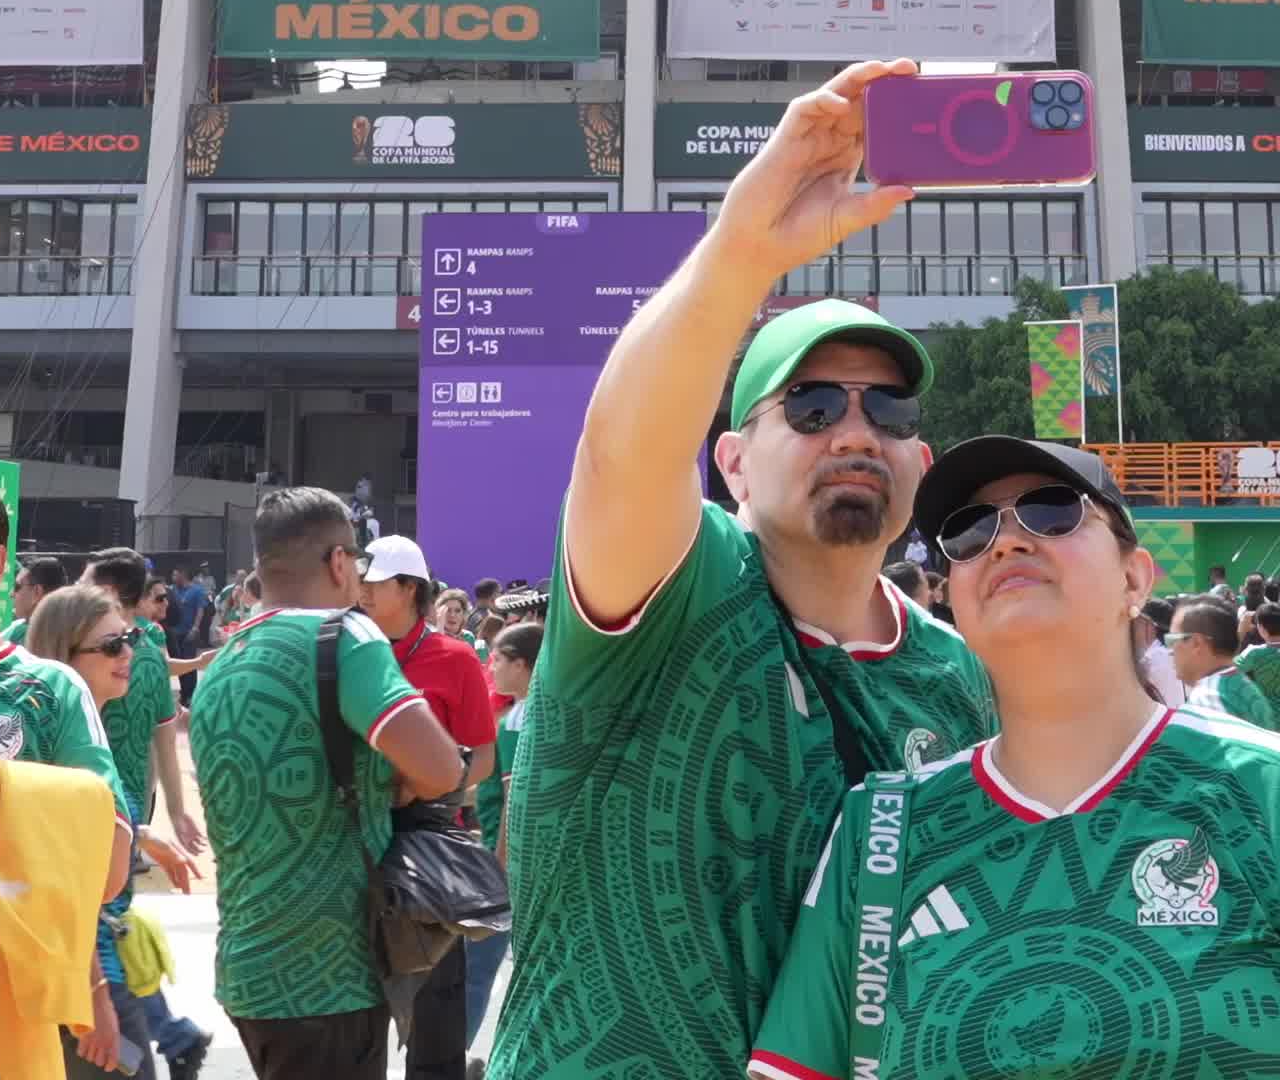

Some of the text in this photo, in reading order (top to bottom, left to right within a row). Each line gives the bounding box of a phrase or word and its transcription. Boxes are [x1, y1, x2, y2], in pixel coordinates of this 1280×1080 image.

[372, 115, 456, 147] 26
[697, 126, 742, 140] COPA
[20, 130, 141, 152] MÉXICO
[1144, 134, 1234, 152] BIENVENIDOS
[1234, 134, 1246, 152] A
[372, 147, 456, 156] COPA MUNDIAL
[685, 142, 707, 155] DE
[709, 142, 731, 155] LA
[546, 215, 579, 228] FIFA
[466, 248, 534, 257] RAMPAS RAMPS
[466, 261, 477, 275] 4
[466, 287, 534, 296] RAMPAS RAMPS
[595, 286, 633, 296] RAMPAS
[407, 304, 422, 323] 4
[466, 325, 545, 336] TÚNELES TUNNELS
[578, 325, 619, 335] TÚNELES
[1139, 908, 1216, 923] MÉXICO
[853, 904, 894, 1027] MEXICO
